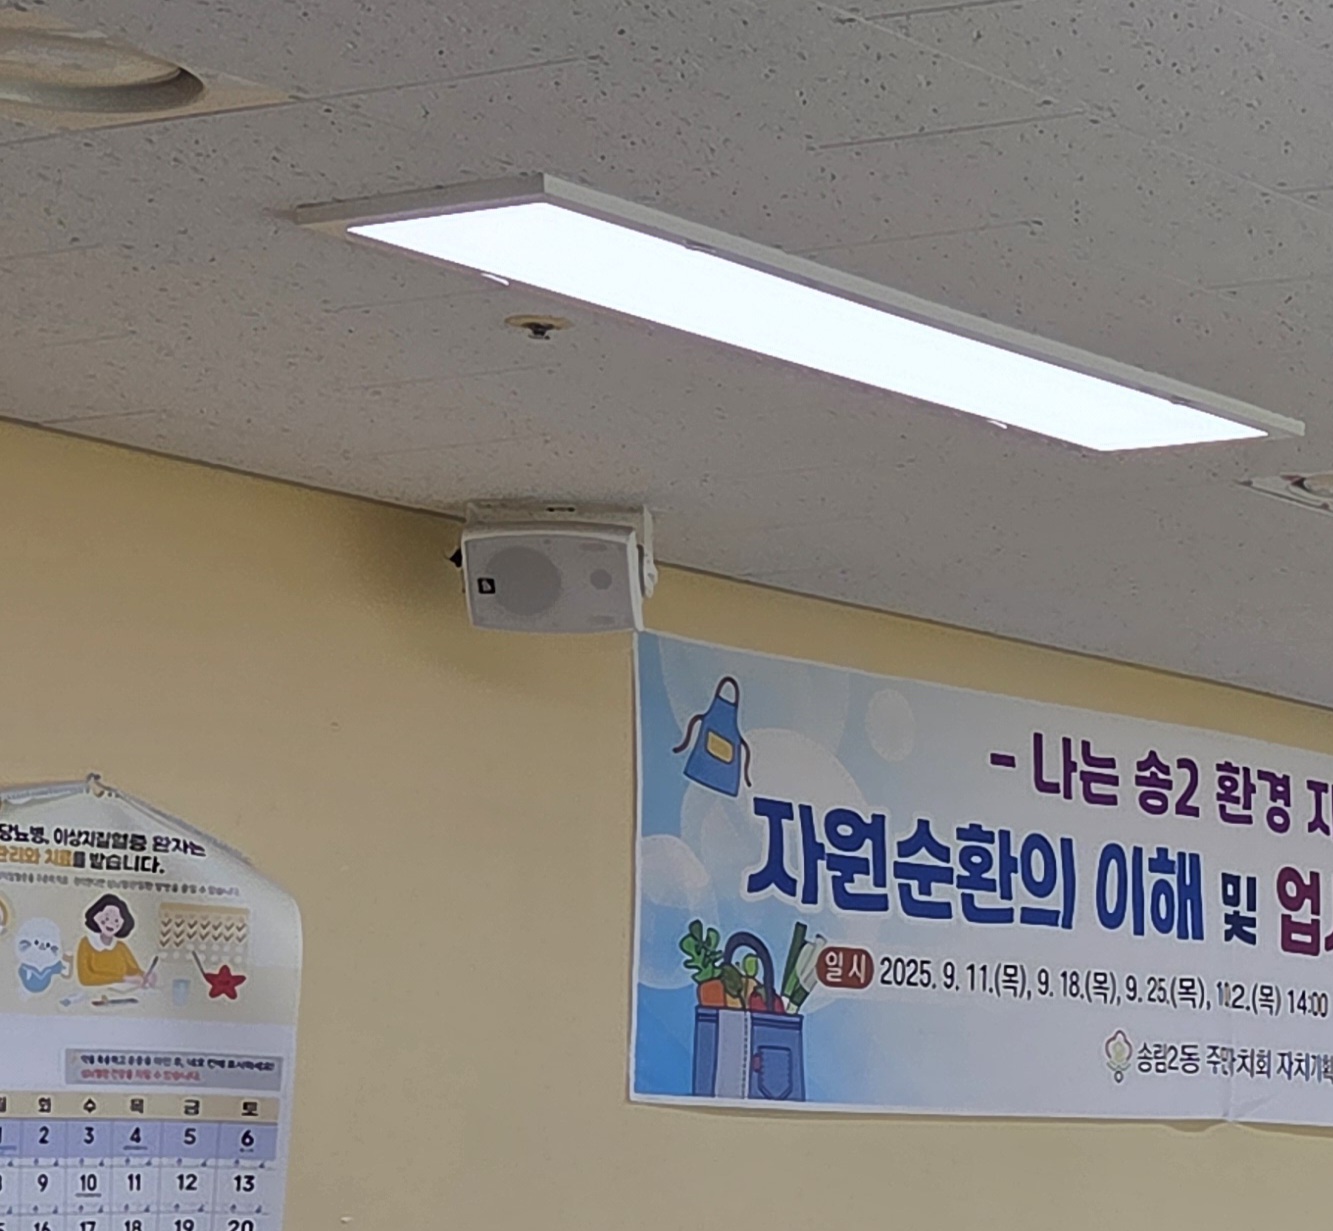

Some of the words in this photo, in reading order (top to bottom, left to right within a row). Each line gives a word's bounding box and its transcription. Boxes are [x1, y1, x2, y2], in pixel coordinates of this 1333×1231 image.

[1033, 731, 1119, 806] 나는
[1134, 749, 1200, 818] 송2
[1215, 761, 1291, 834] 환경
[747, 797, 1076, 929] 자원순환의
[1096, 843, 1204, 941] 이해
[1221, 873, 1257, 946] 및
[880, 956, 937, 990] 2025.
[1136, 1042, 1200, 1074] 송림2동
[38, 1127, 50, 1145] 2
[83, 1127, 95, 1145] 3
[129, 1127, 142, 1145] 4
[183, 1128, 196, 1146] 5
[241, 1129, 254, 1148] 6
[37, 1174, 48, 1192] 9
[80, 1174, 98, 1192] 10
[127, 1173, 142, 1192] 11
[177, 1173, 198, 1192] 12
[233, 1174, 255, 1193] 13
